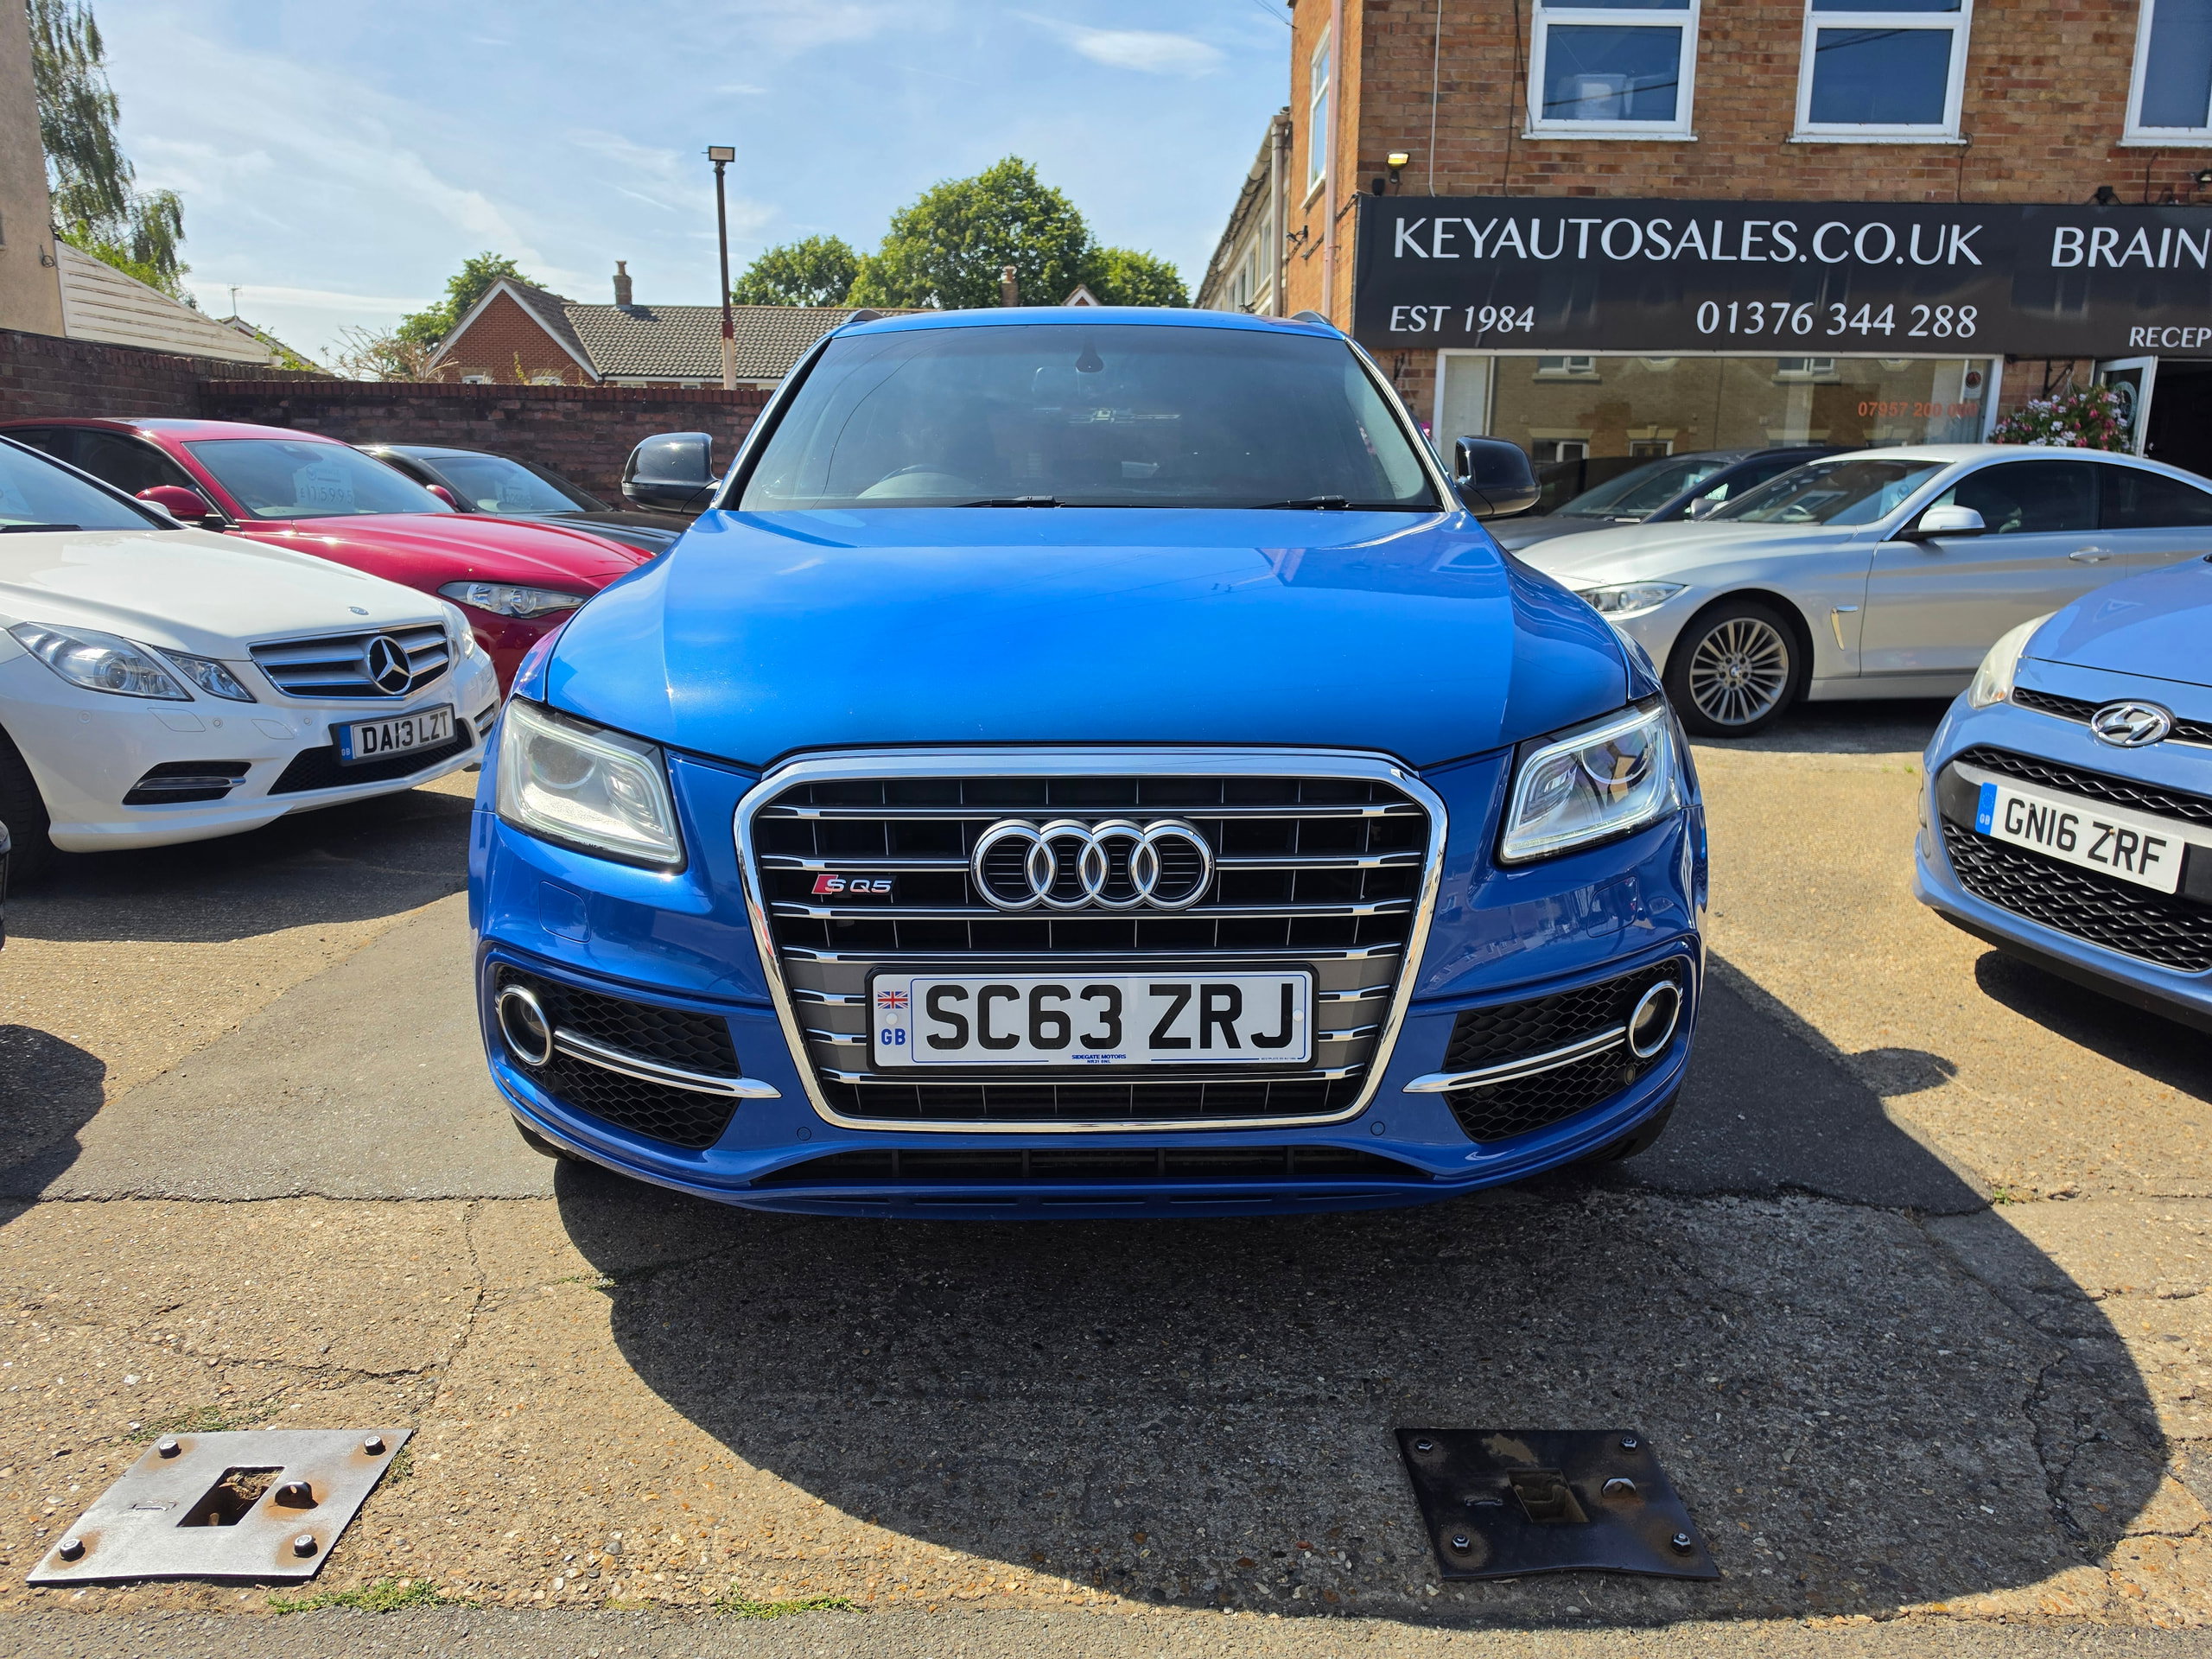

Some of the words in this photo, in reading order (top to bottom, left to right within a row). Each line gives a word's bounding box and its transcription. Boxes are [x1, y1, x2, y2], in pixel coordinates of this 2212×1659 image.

[1394, 217, 1984, 266] KEYAUTOSALES.CO.UK
[1389, 305, 1452, 333] EST
[1465, 305, 1535, 334] 1984
[1695, 300, 1815, 336] 01376
[1826, 302, 1896, 336] 344
[1907, 303, 1979, 339] 288
[1858, 401, 1909, 417] 07957
[361, 721, 414, 754] DA13
[418, 711, 448, 743] LZT
[1980, 813, 1991, 826] GB
[2005, 798, 2079, 853] GN16
[2087, 821, 2167, 875] ZRF
[925, 984, 1122, 1050] SC63
[1148, 982, 1294, 1049] ZRJ
[880, 1028, 906, 1046] GB
